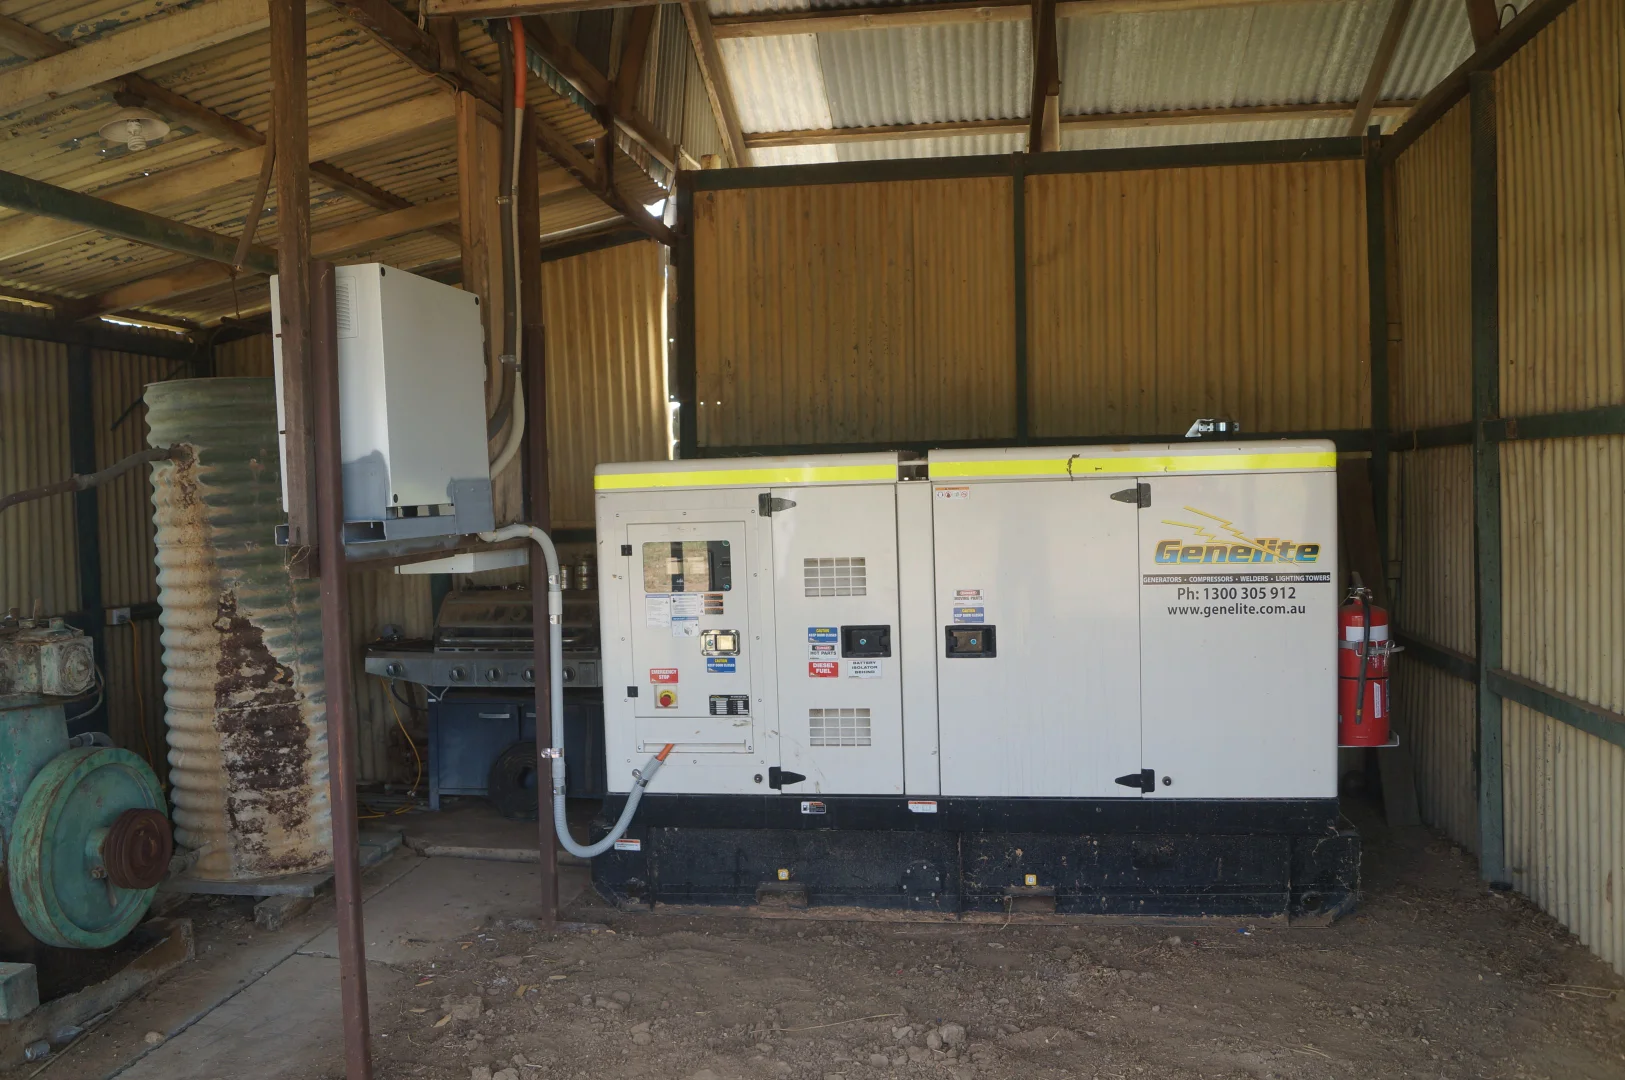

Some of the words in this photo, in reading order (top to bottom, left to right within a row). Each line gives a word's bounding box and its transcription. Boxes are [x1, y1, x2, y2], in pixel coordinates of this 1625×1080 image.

[1154, 537, 1321, 565] Genelite
[1189, 575, 1234, 583] COMPRESSORS
[1177, 587, 1200, 600] Ph:
[1203, 587, 1238, 600] 1300
[1241, 587, 1266, 600] 305
[1270, 587, 1296, 599] 912
[1167, 603, 1306, 617] www.genelite.com.au
